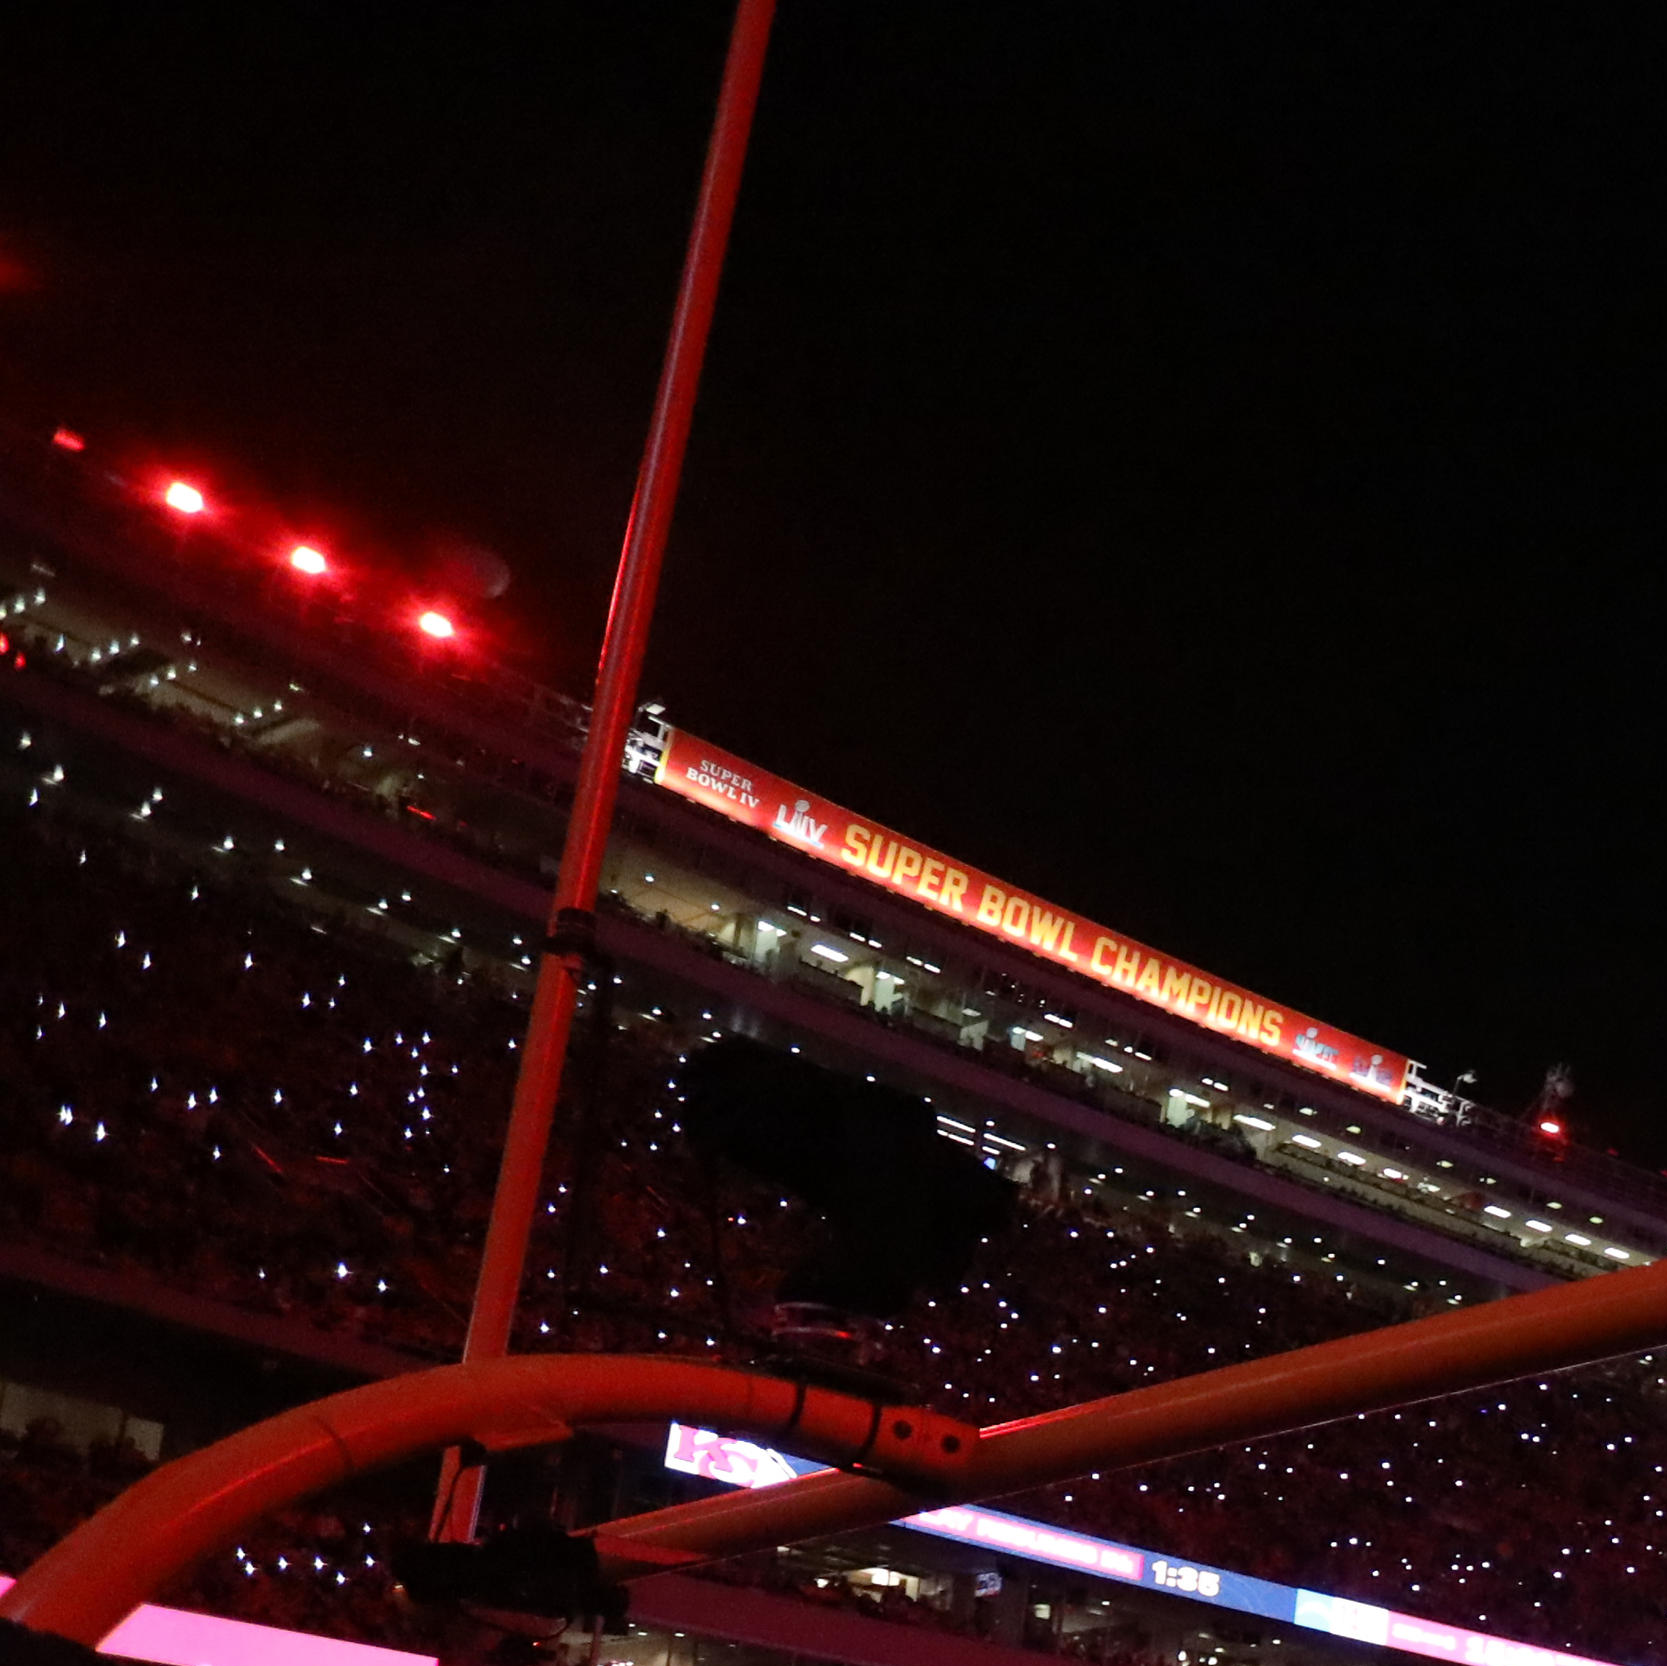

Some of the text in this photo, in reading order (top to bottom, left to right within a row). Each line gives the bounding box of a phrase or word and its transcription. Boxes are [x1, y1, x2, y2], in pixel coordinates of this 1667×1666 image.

[686, 767, 760, 808] BOWL IV
[700, 759, 753, 792] SUPER
[841, 824, 1283, 1046] SUPER BOWL CHAMPIONS
[1152, 1559, 1221, 1598] 1:35
